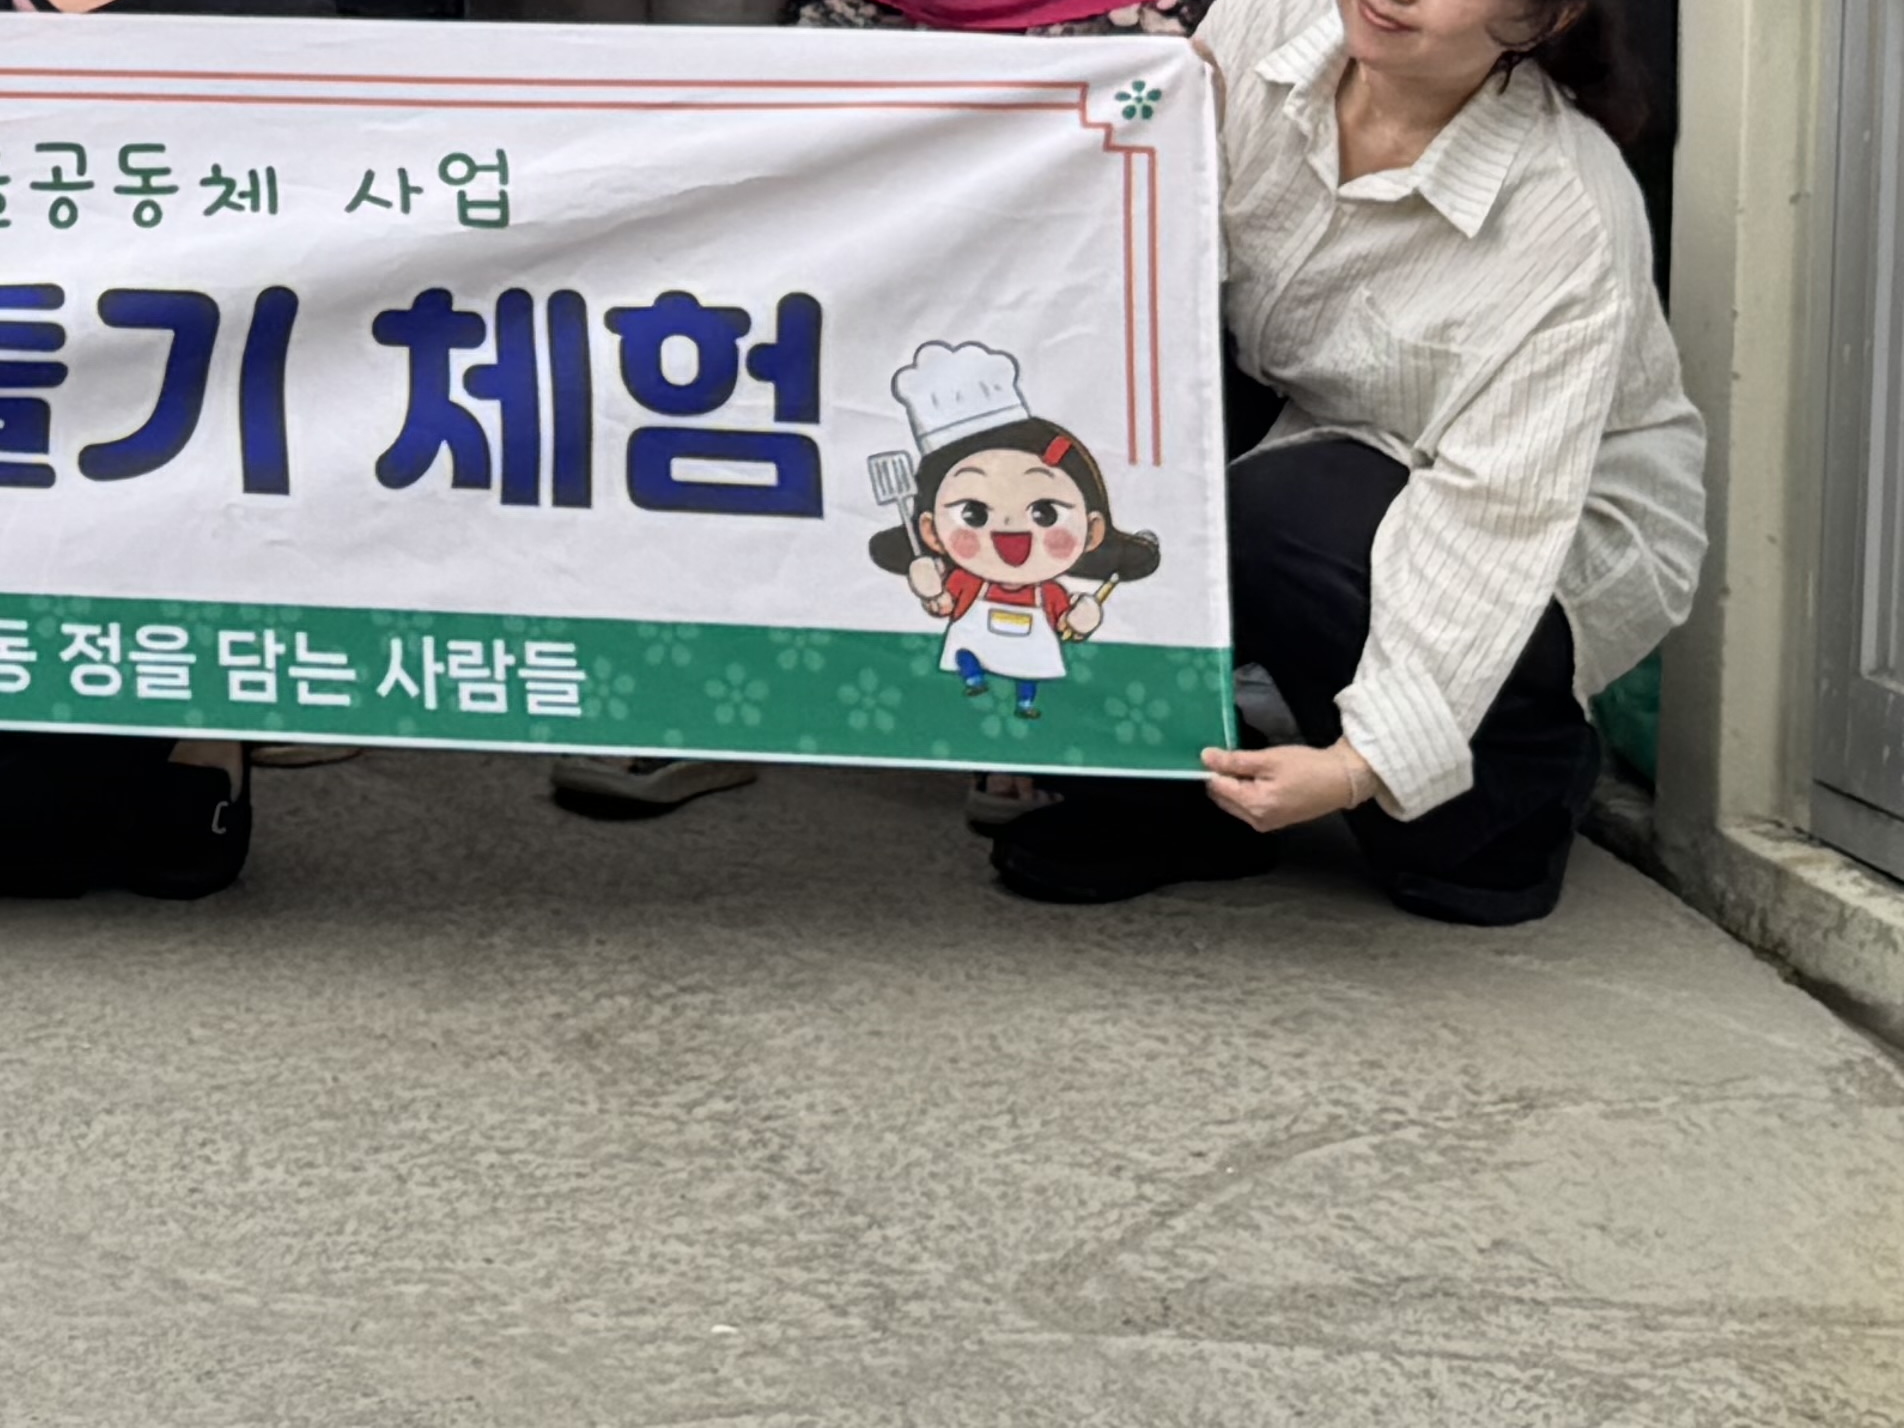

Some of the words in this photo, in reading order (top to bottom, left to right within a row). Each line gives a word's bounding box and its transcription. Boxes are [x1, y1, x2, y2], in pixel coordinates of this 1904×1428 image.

[344, 148, 511, 230] 사업
[370, 286, 825, 520] 체험
[58, 622, 197, 701] 정을
[217, 629, 357, 707] 담는
[376, 635, 588, 718] 사람들
